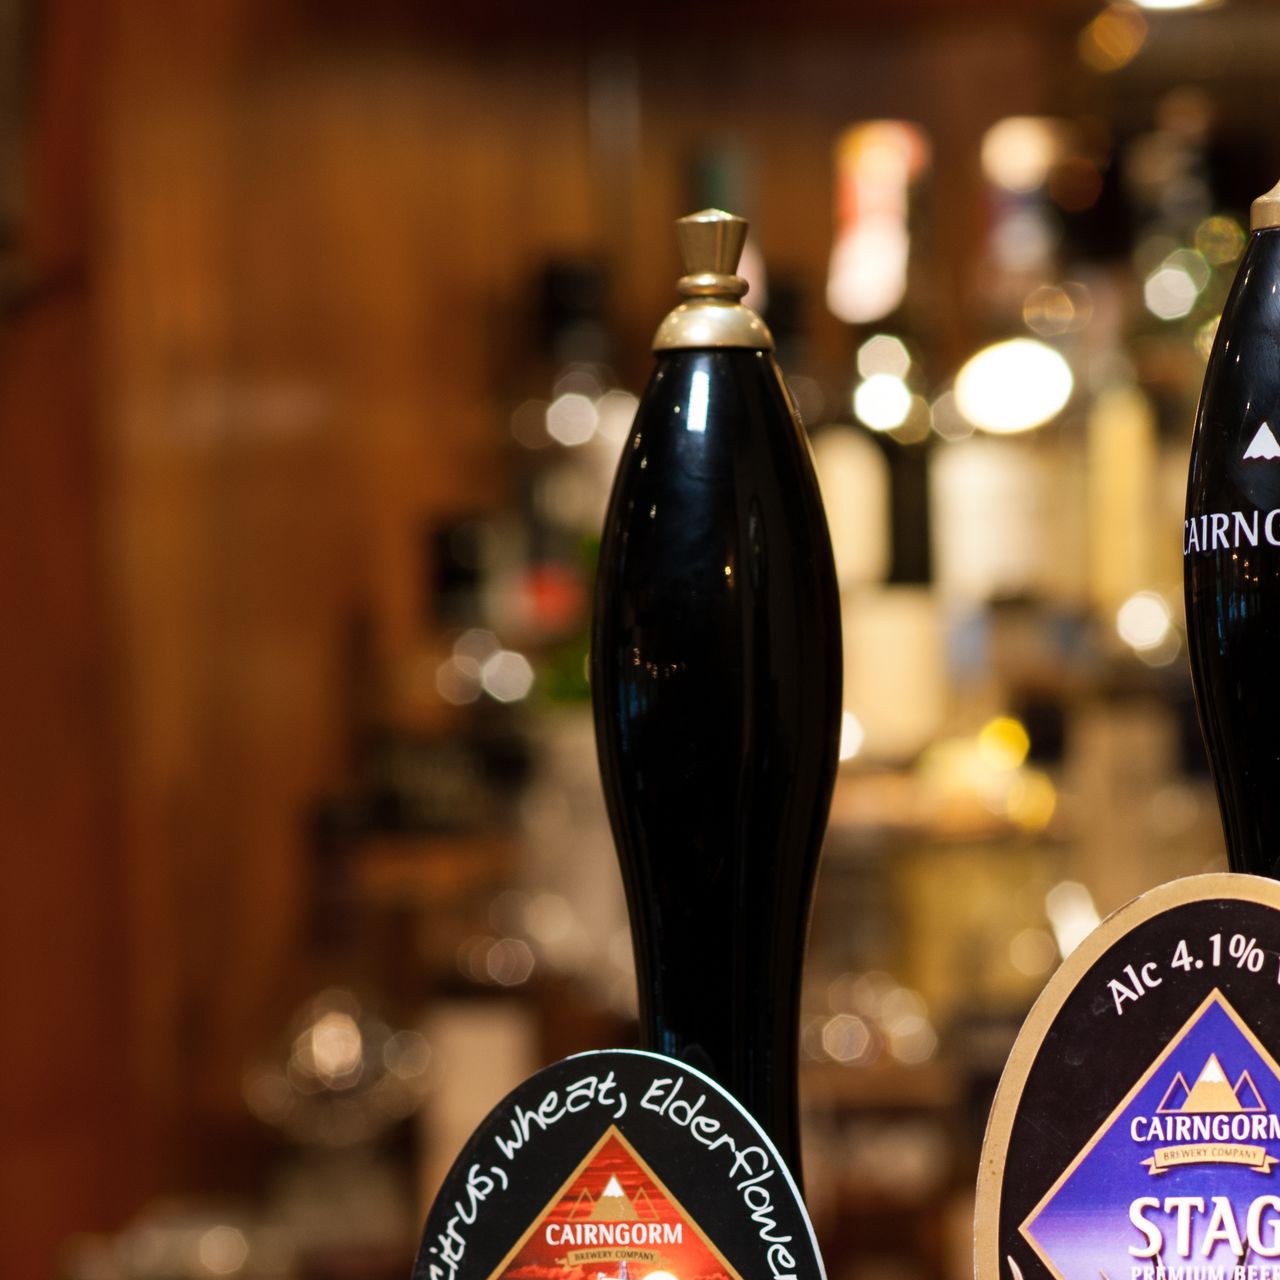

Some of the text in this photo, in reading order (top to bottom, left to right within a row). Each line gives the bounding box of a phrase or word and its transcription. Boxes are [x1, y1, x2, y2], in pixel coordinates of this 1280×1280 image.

[1105, 961, 1163, 1016] Alc
[1171, 933, 1265, 974] 4.1%
[495, 1071, 628, 1160] wheat,
[1163, 1147, 1257, 1161] BREWERY COMPANY
[545, 1222, 683, 1246] CAIRNGORM
[574, 1250, 655, 1261] BREWERY COMPANY
